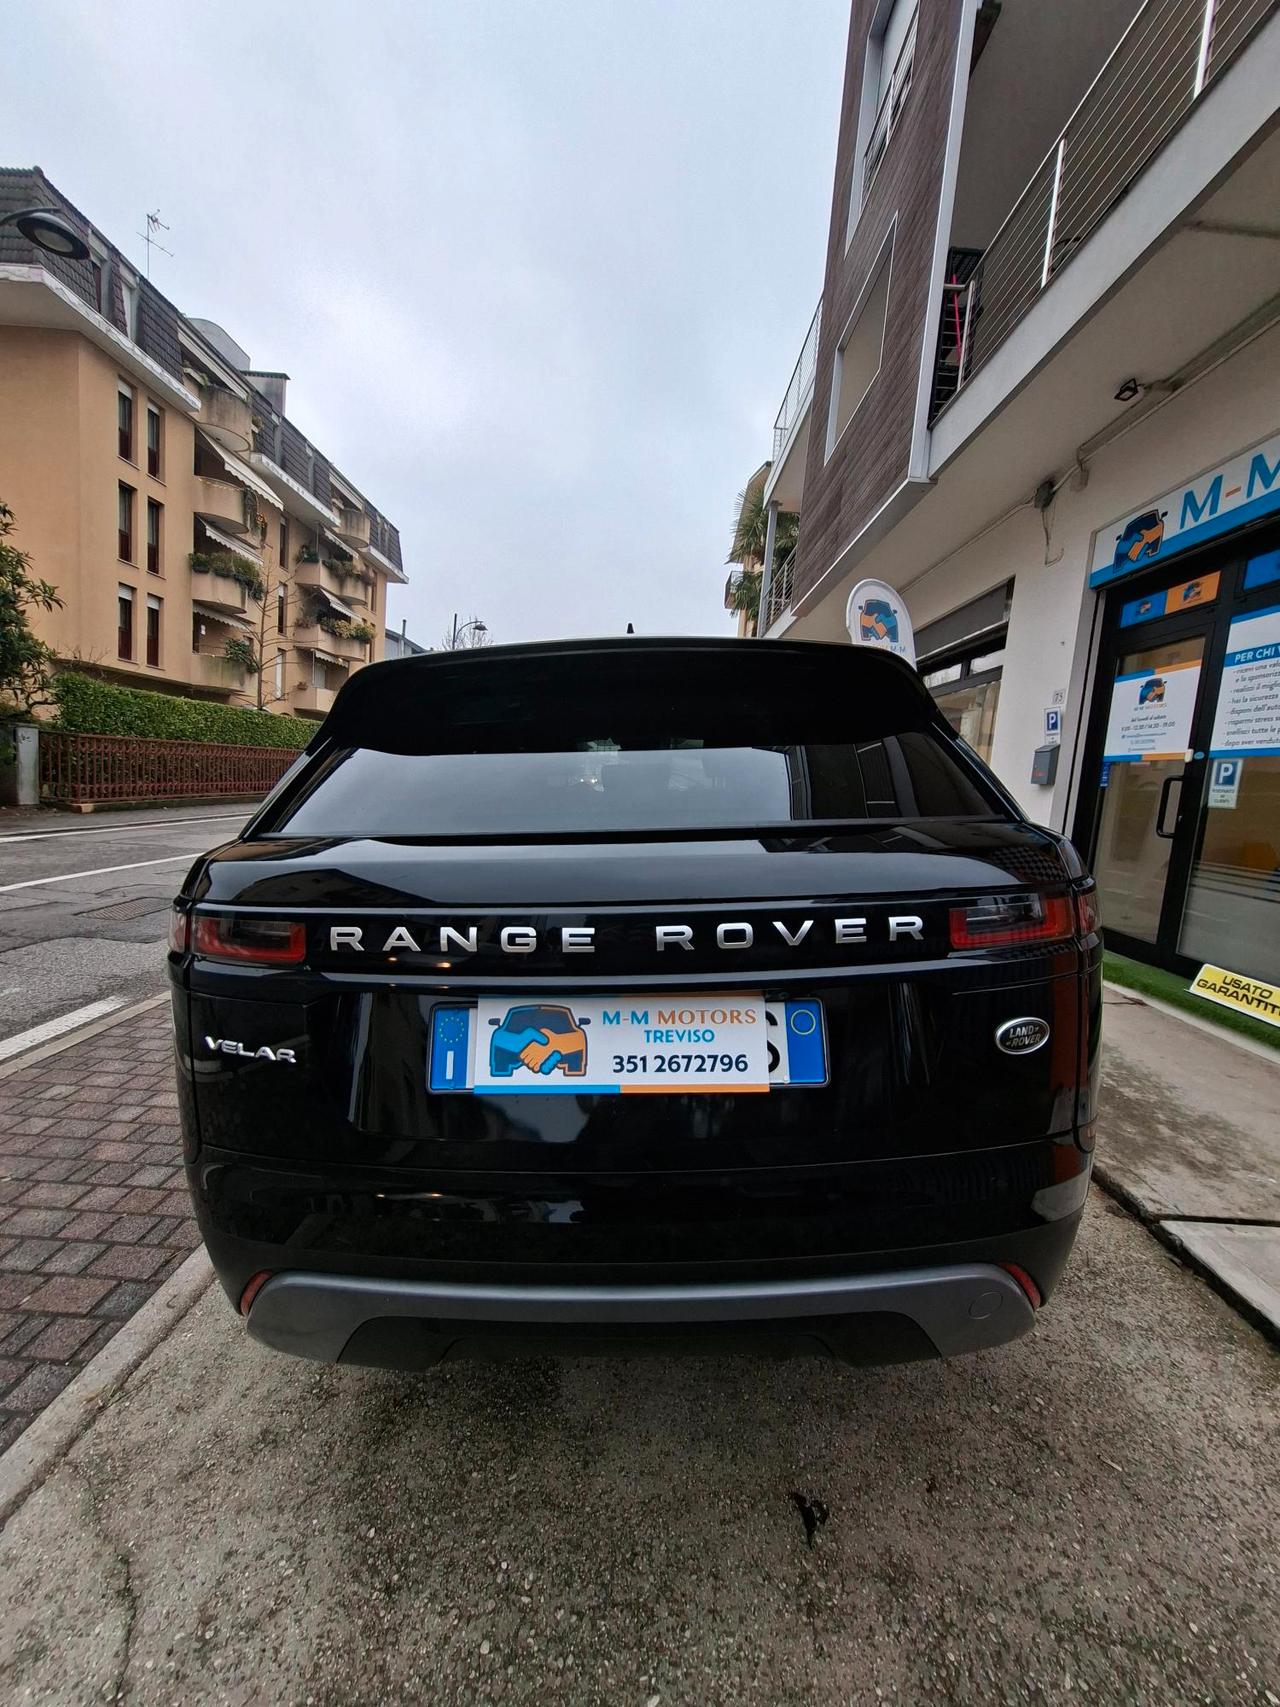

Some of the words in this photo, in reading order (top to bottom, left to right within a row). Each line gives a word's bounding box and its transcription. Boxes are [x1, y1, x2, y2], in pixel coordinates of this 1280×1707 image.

[1234, 651, 1254, 664] PER
[1255, 646, 1275, 659] CHI
[329, 926, 596, 953] RANGE
[655, 915, 925, 952] ROVER
[1222, 975, 1273, 1000] USATO
[602, 1010, 649, 1026] M-M
[657, 1009, 757, 1026] MOTORS
[643, 1028, 715, 1044] TREVISO
[1009, 1024, 1034, 1039] LAND
[1011, 1033, 1041, 1048] ROVER
[204, 1035, 297, 1063] VELAR
[612, 1054, 647, 1074] 351
[653, 1053, 749, 1074] 2672796
